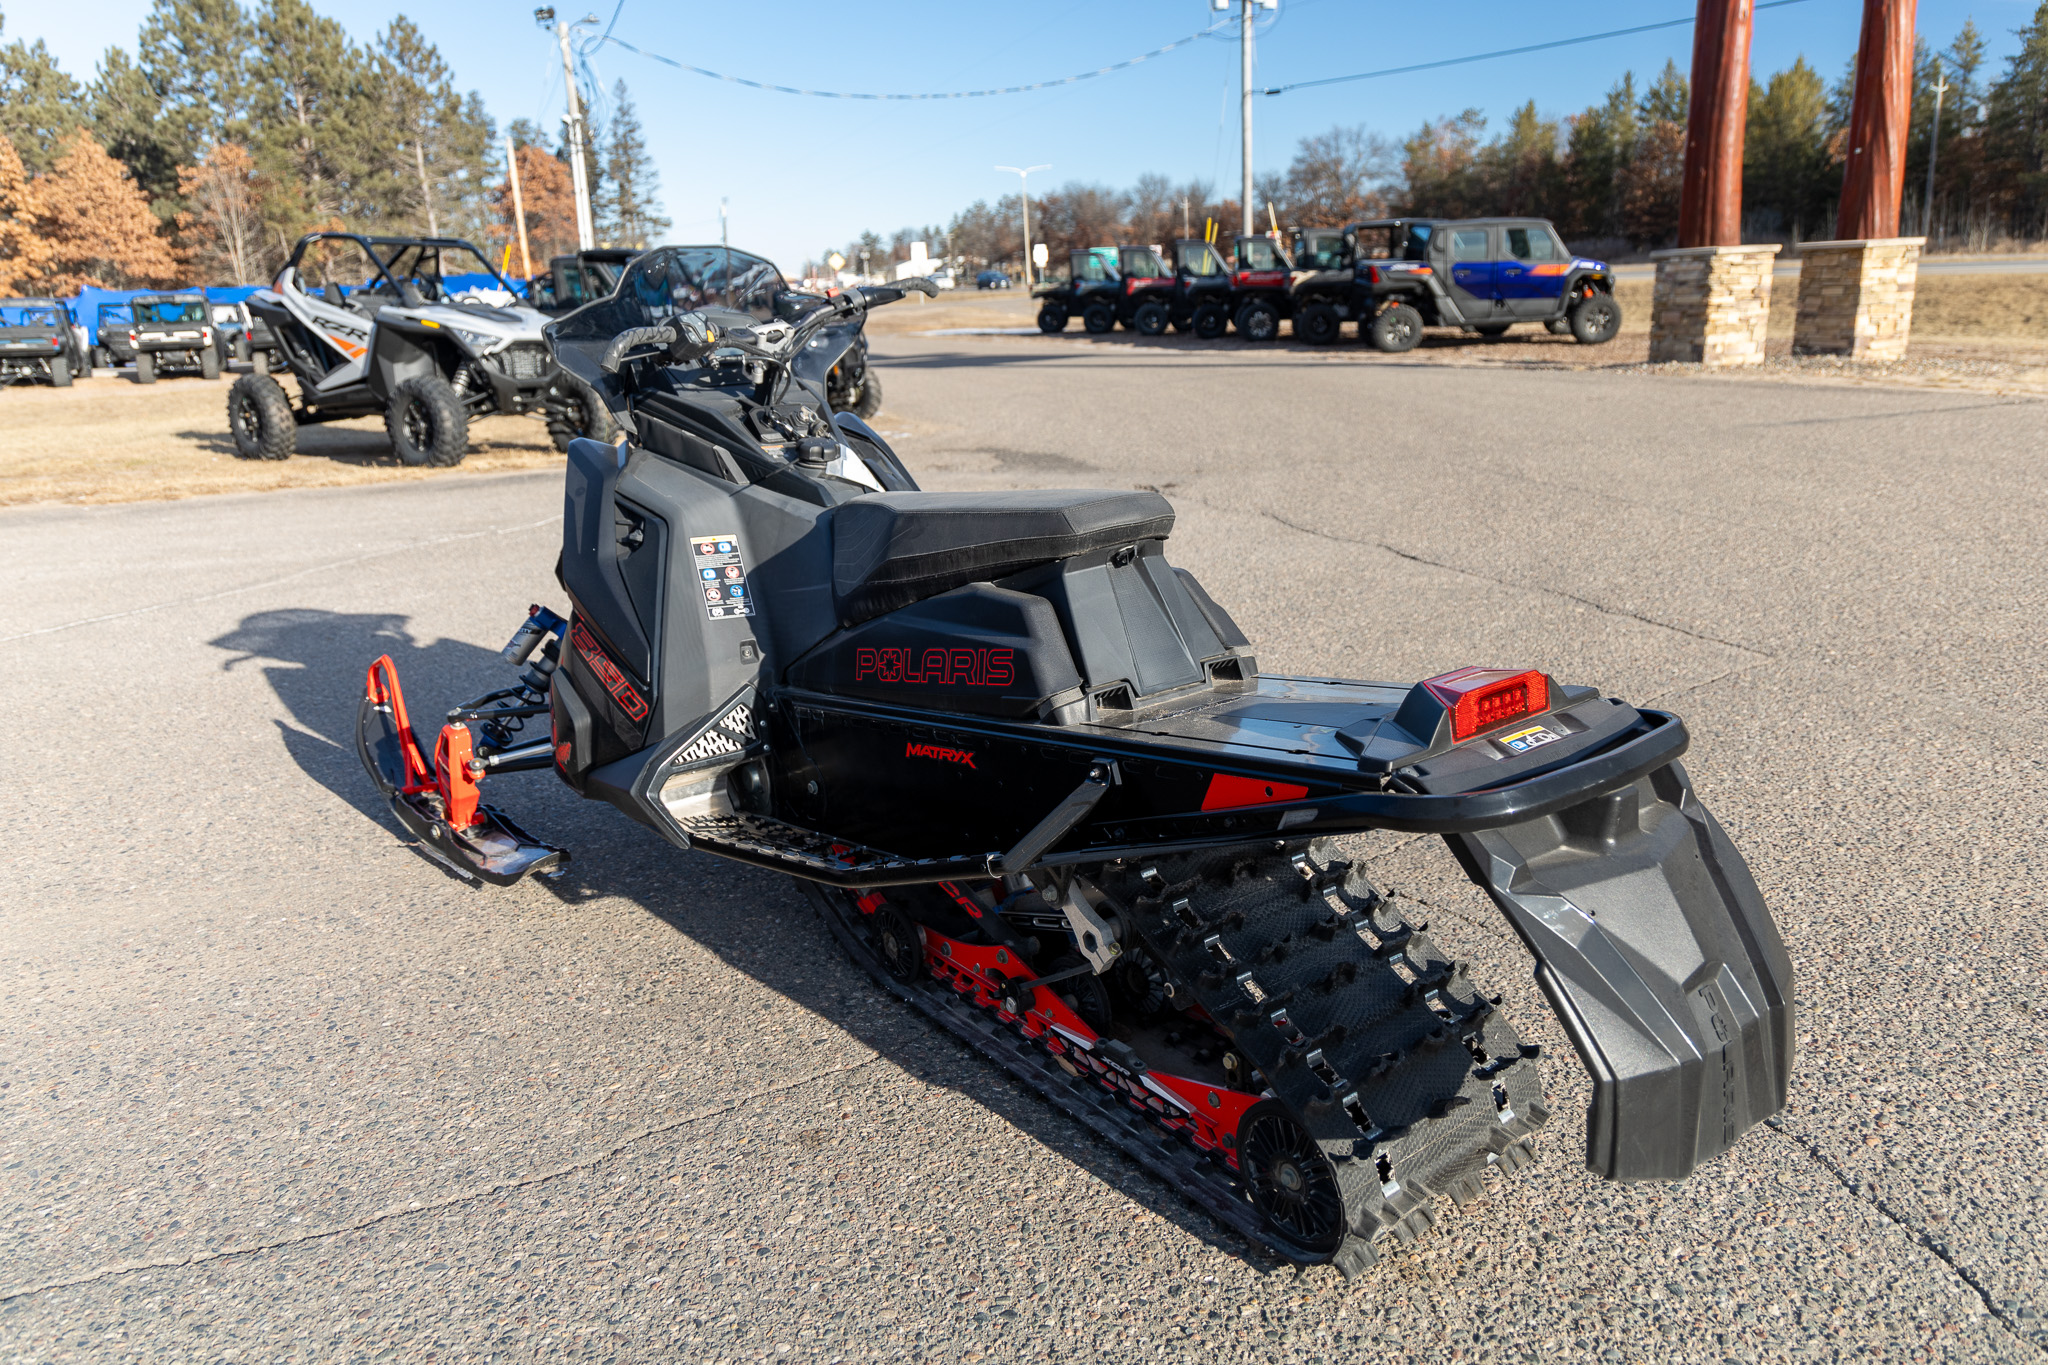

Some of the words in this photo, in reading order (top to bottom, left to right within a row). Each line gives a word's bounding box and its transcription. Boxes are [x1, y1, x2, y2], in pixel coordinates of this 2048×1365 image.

[312, 316, 368, 341] RZR
[569, 622, 649, 721] 850
[856, 648, 1014, 686] POLARIS
[905, 742, 977, 769] MATRYX
[938, 881, 983, 919] CR
[1698, 984, 1736, 1146] POLARIS
